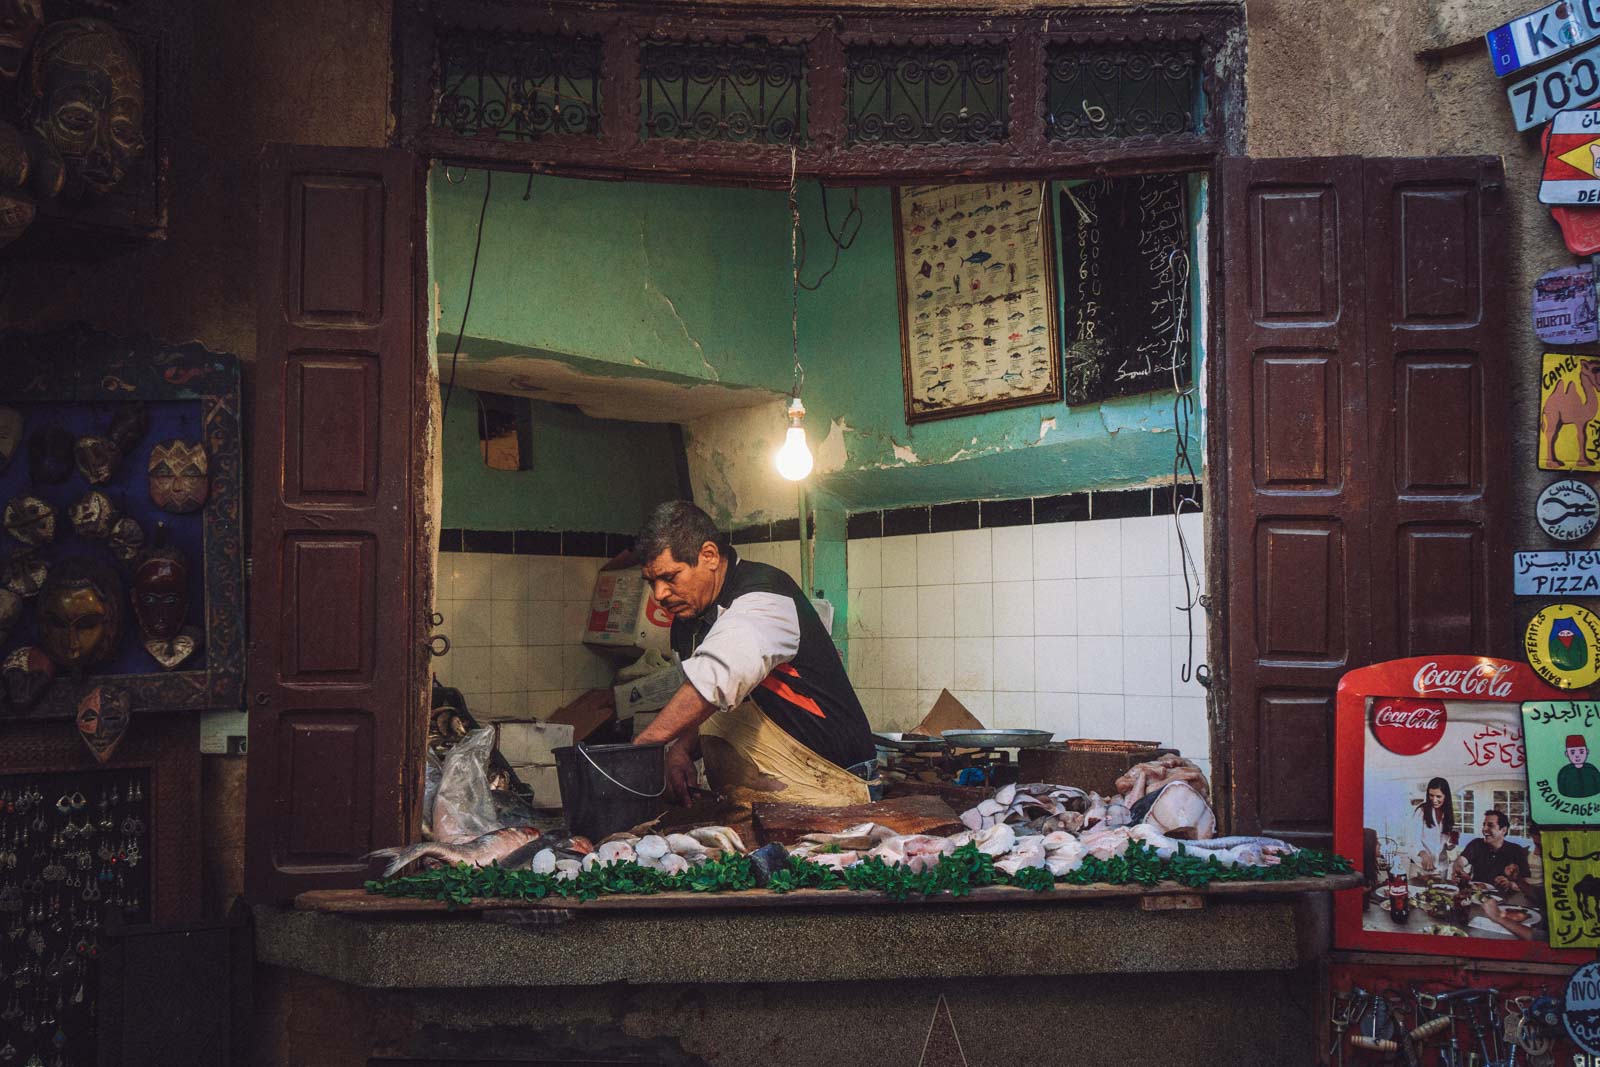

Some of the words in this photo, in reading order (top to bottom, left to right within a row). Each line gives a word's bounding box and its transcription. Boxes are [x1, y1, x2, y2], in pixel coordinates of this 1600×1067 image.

[1525, 13, 1559, 56] K
[1501, 54, 1511, 66] D
[1542, 355, 1578, 390] CAMEL
[1532, 575, 1598, 593] PIZZA
[1528, 613, 1546, 653] FEMMES
[1412, 662, 1515, 697] Coca-Cola
[1538, 666, 1562, 685] BAIN
[1375, 706, 1444, 730] Coca-Cola
